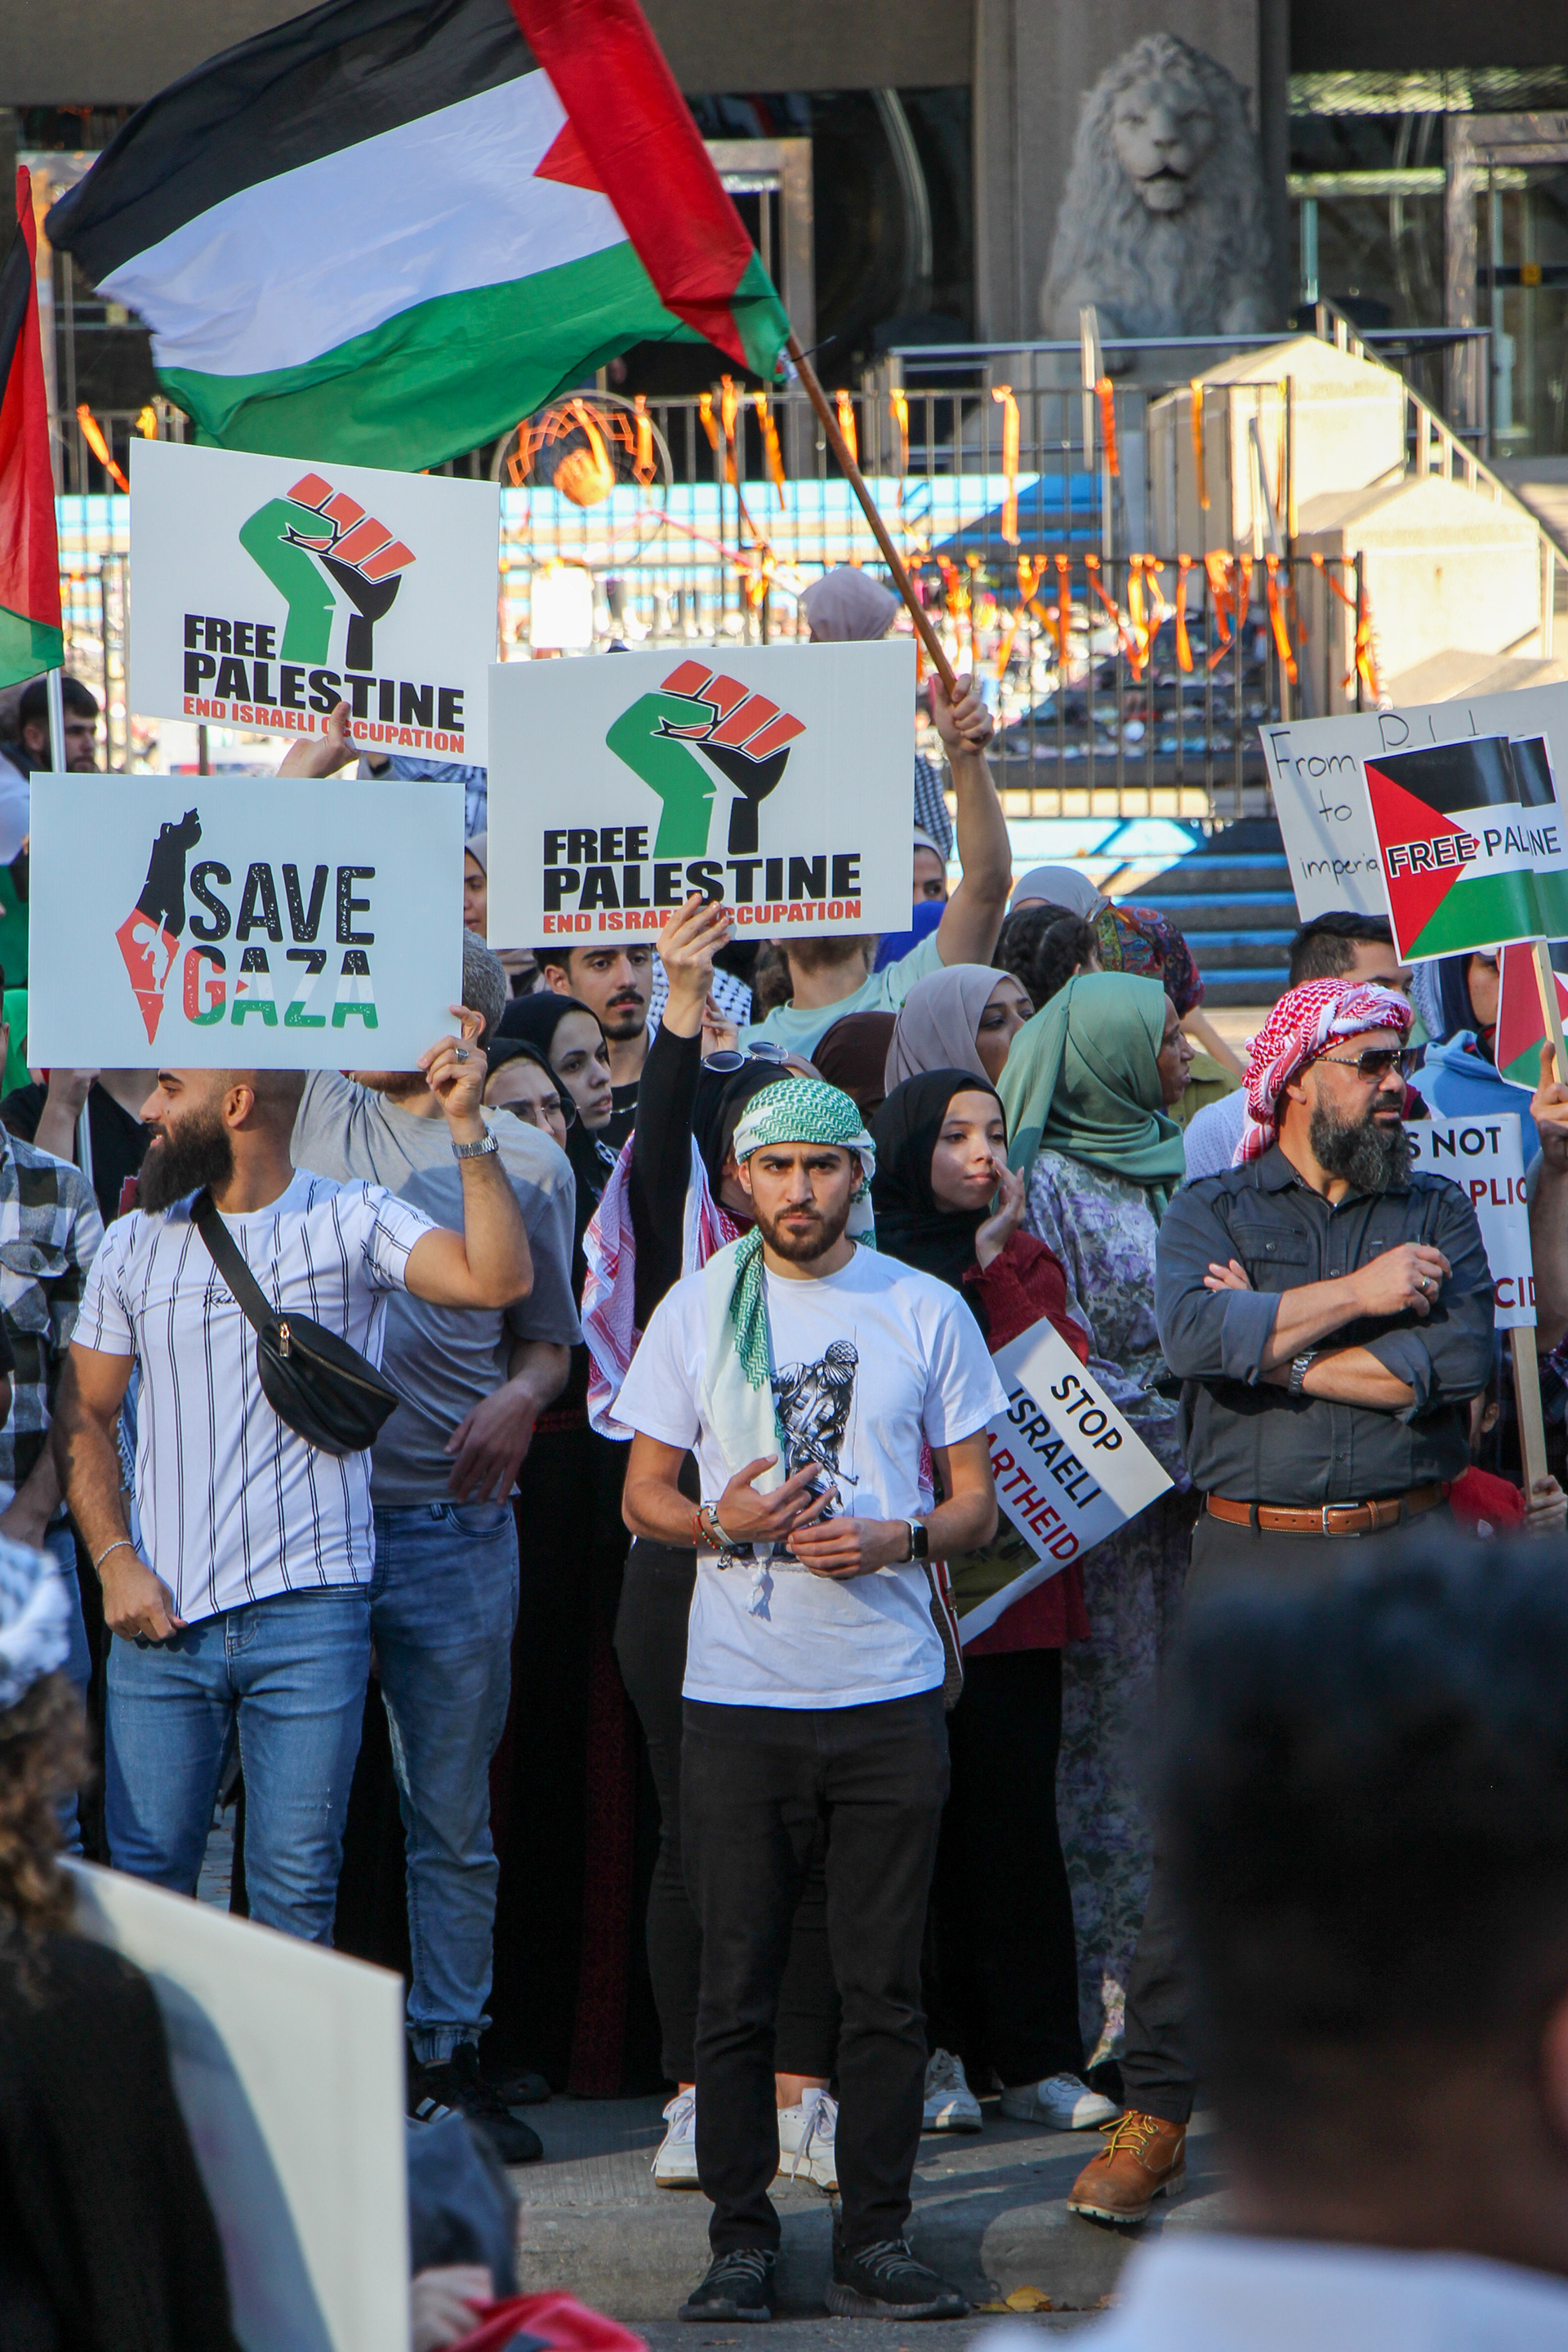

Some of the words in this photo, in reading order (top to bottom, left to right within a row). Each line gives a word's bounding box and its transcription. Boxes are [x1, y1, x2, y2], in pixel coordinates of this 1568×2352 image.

[184, 613, 276, 660] FREE
[184, 651, 465, 732] PALESTINE
[184, 697, 225, 719] END
[232, 705, 315, 733] ISRAELI
[1270, 731, 1356, 779] From
[1319, 789, 1352, 822] to
[543, 826, 649, 866] FREE
[1387, 832, 1477, 878] FREE
[189, 861, 376, 945] SAVE
[543, 853, 862, 912] PALESTINE
[543, 912, 592, 933] END
[599, 908, 678, 932] ISRAE
[705, 900, 862, 928] CCUPATION
[183, 945, 379, 1029] GAZA
[1432, 1126, 1502, 1159] NOT
[1050, 1374, 1123, 1451] STOP
[1007, 1387, 1102, 1509] ISRAELI
